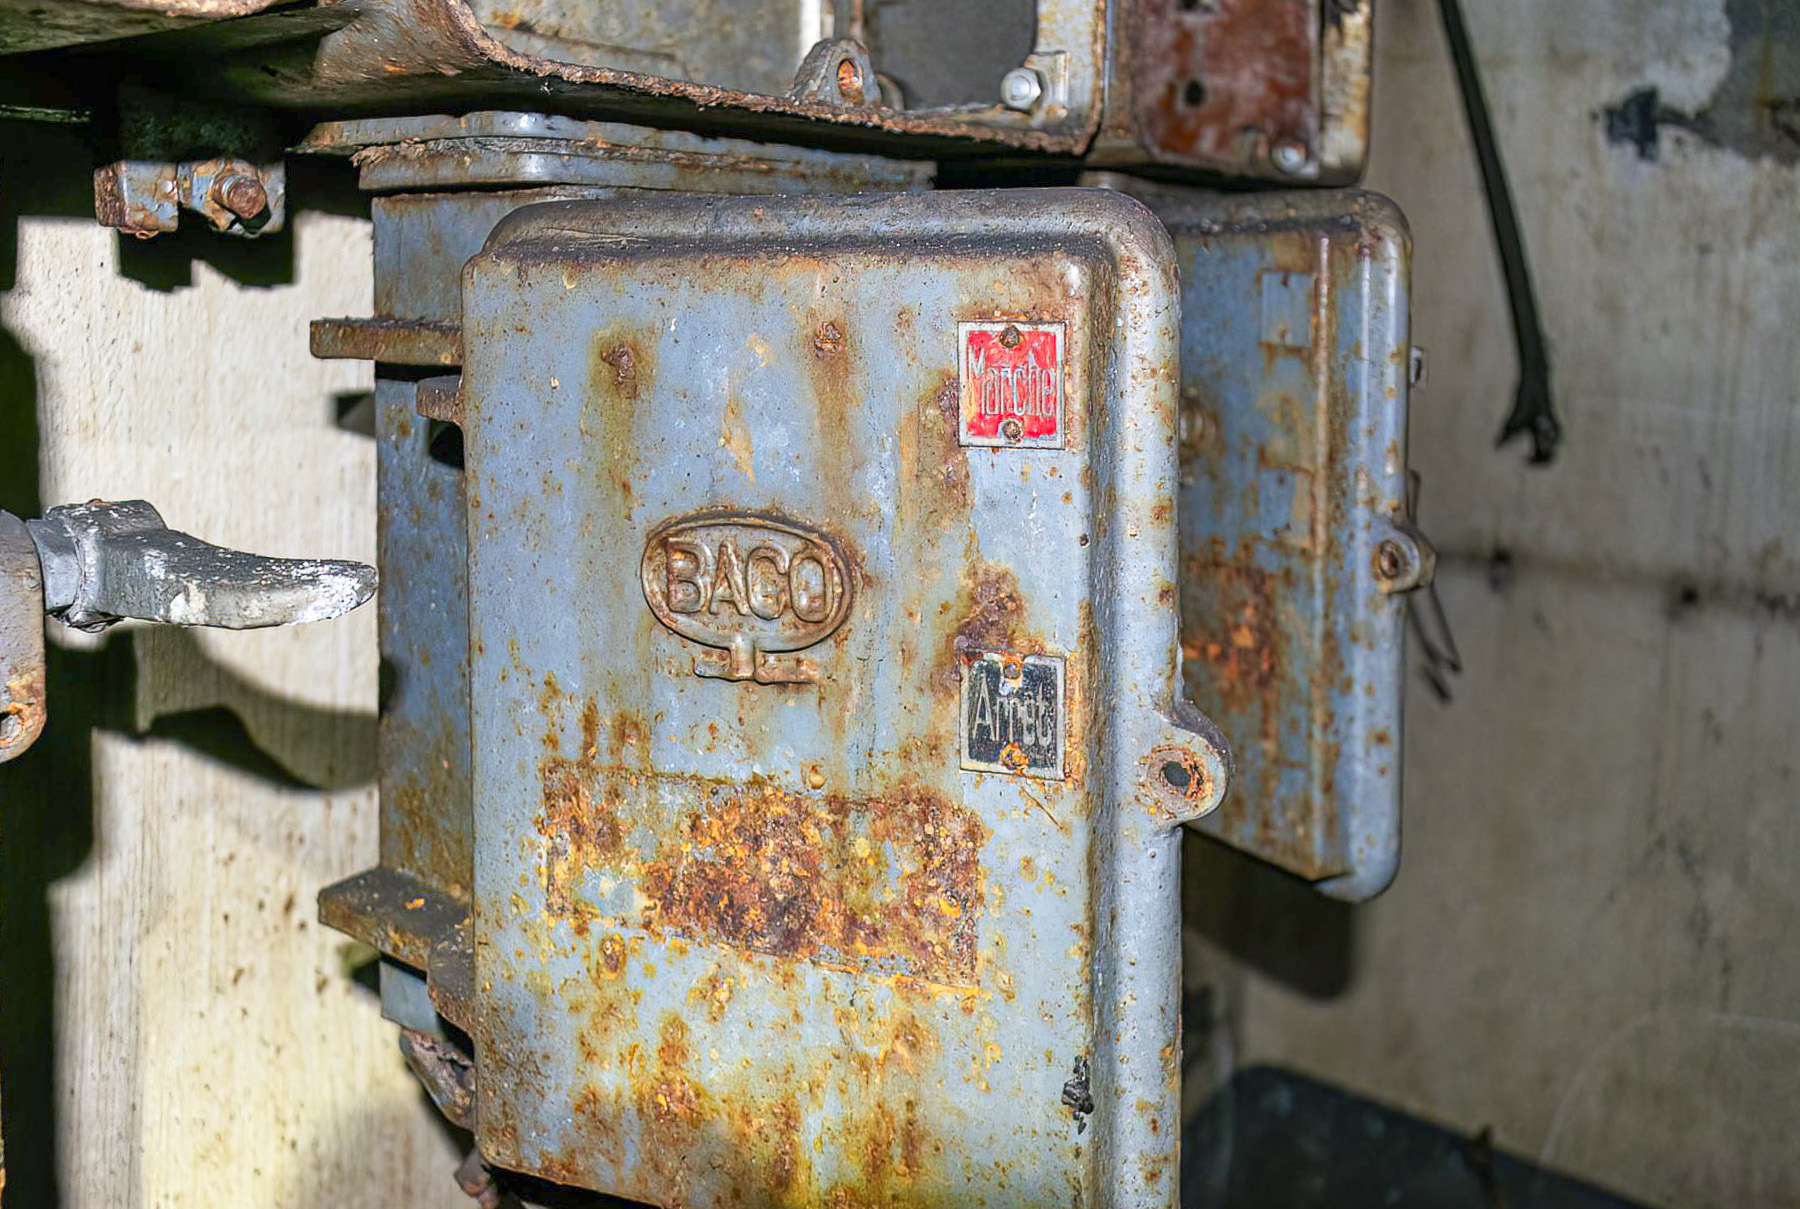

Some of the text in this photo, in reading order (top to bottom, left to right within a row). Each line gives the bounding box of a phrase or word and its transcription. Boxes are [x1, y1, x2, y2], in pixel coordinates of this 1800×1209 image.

[967, 346, 1056, 418] Marche
[666, 537, 834, 623] BACO
[972, 674, 1053, 747] Arrêt
